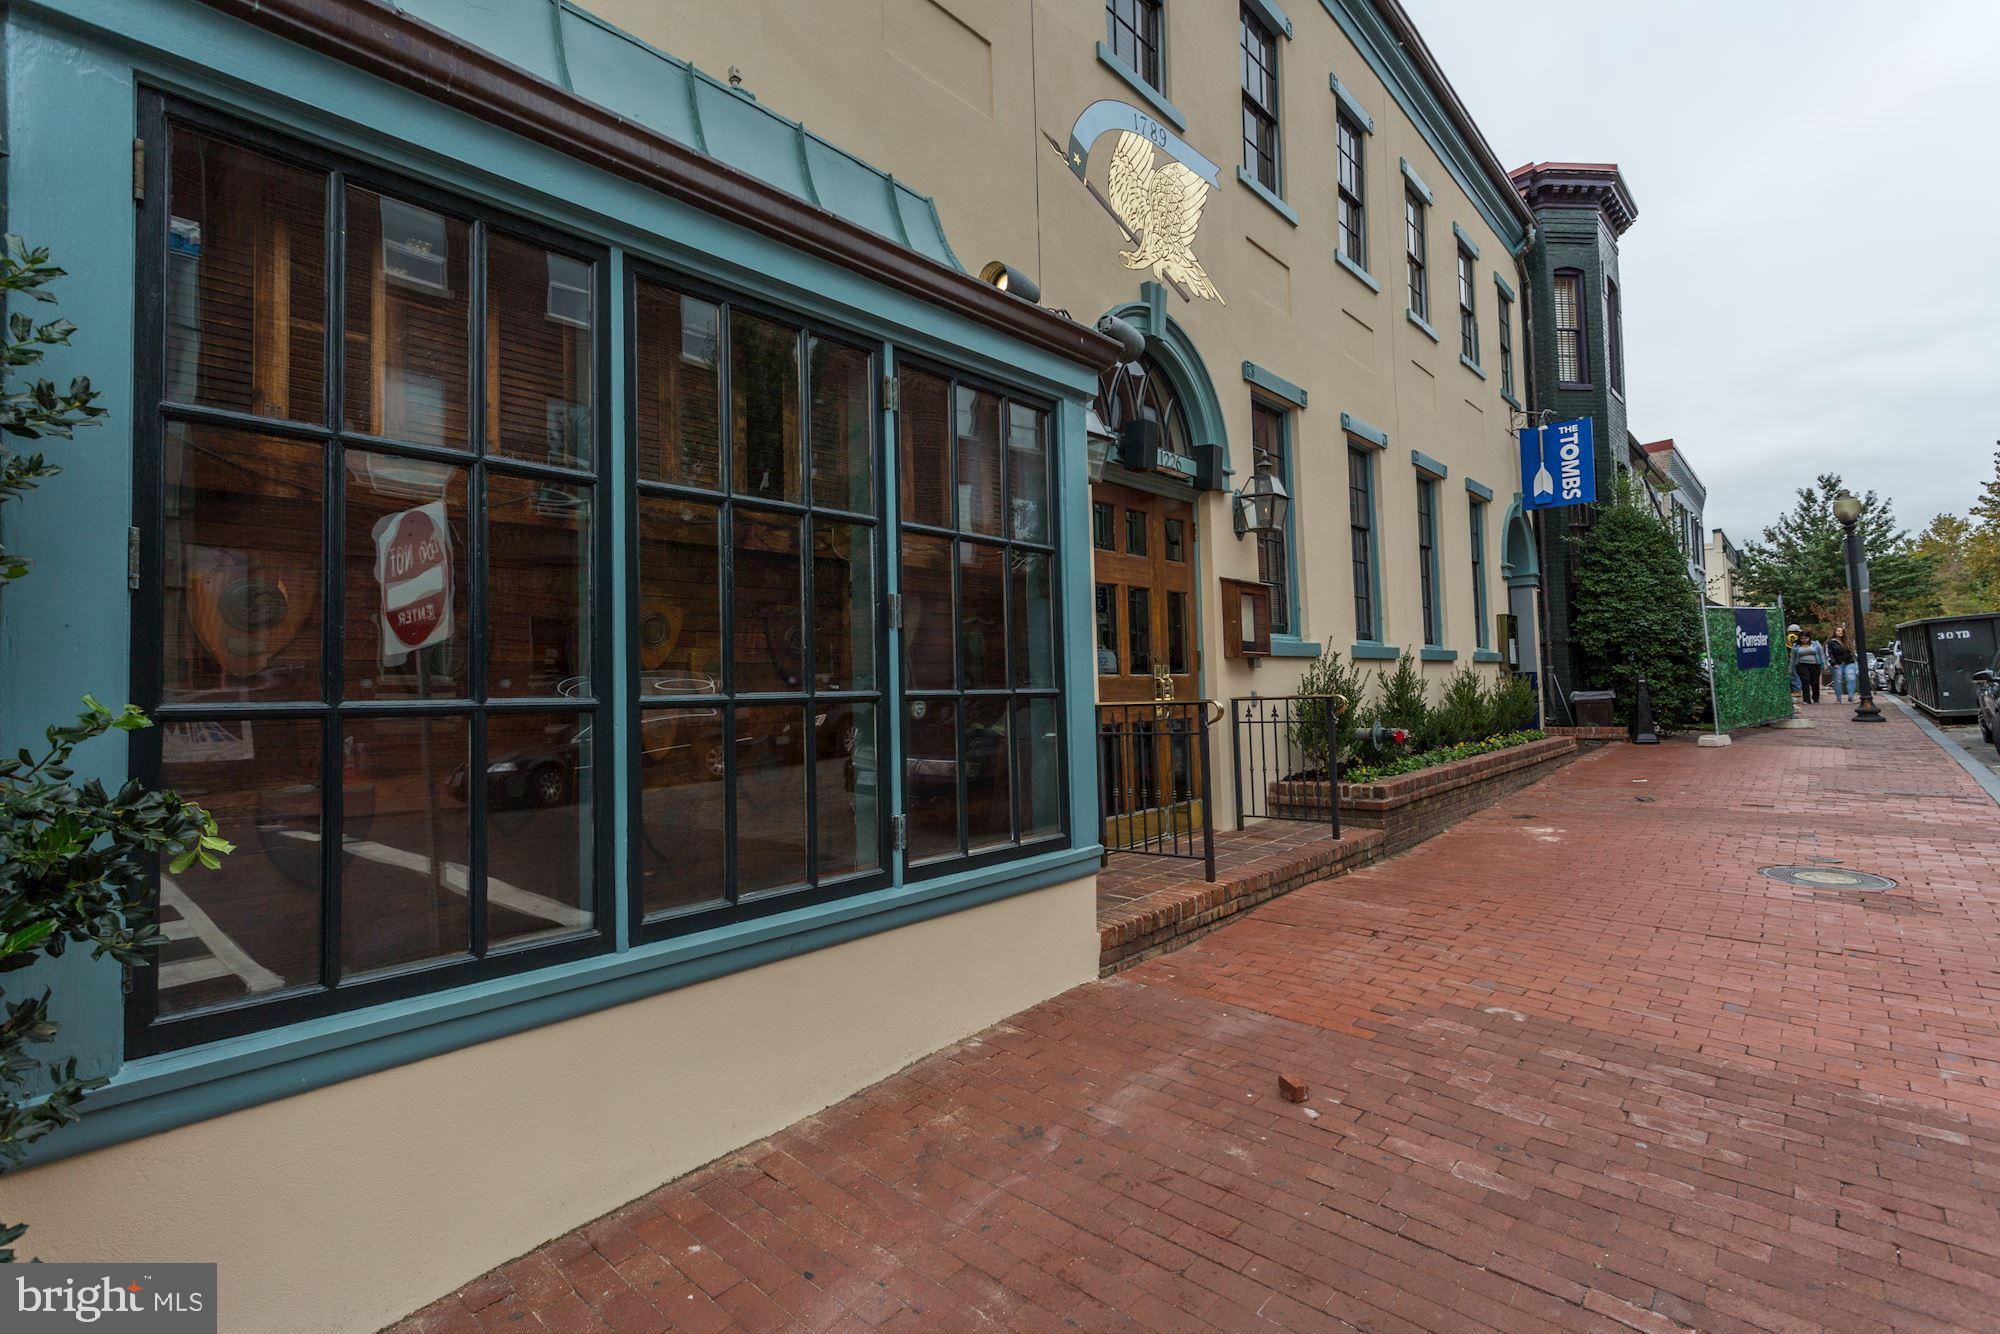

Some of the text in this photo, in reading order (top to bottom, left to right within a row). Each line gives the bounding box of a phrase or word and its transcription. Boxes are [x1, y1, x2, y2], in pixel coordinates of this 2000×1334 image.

[1133, 113, 1167, 148] 1789
[1558, 424, 1579, 435] THE
[1160, 450, 1182, 472] 1226
[1559, 432, 1582, 500] TOMBS
